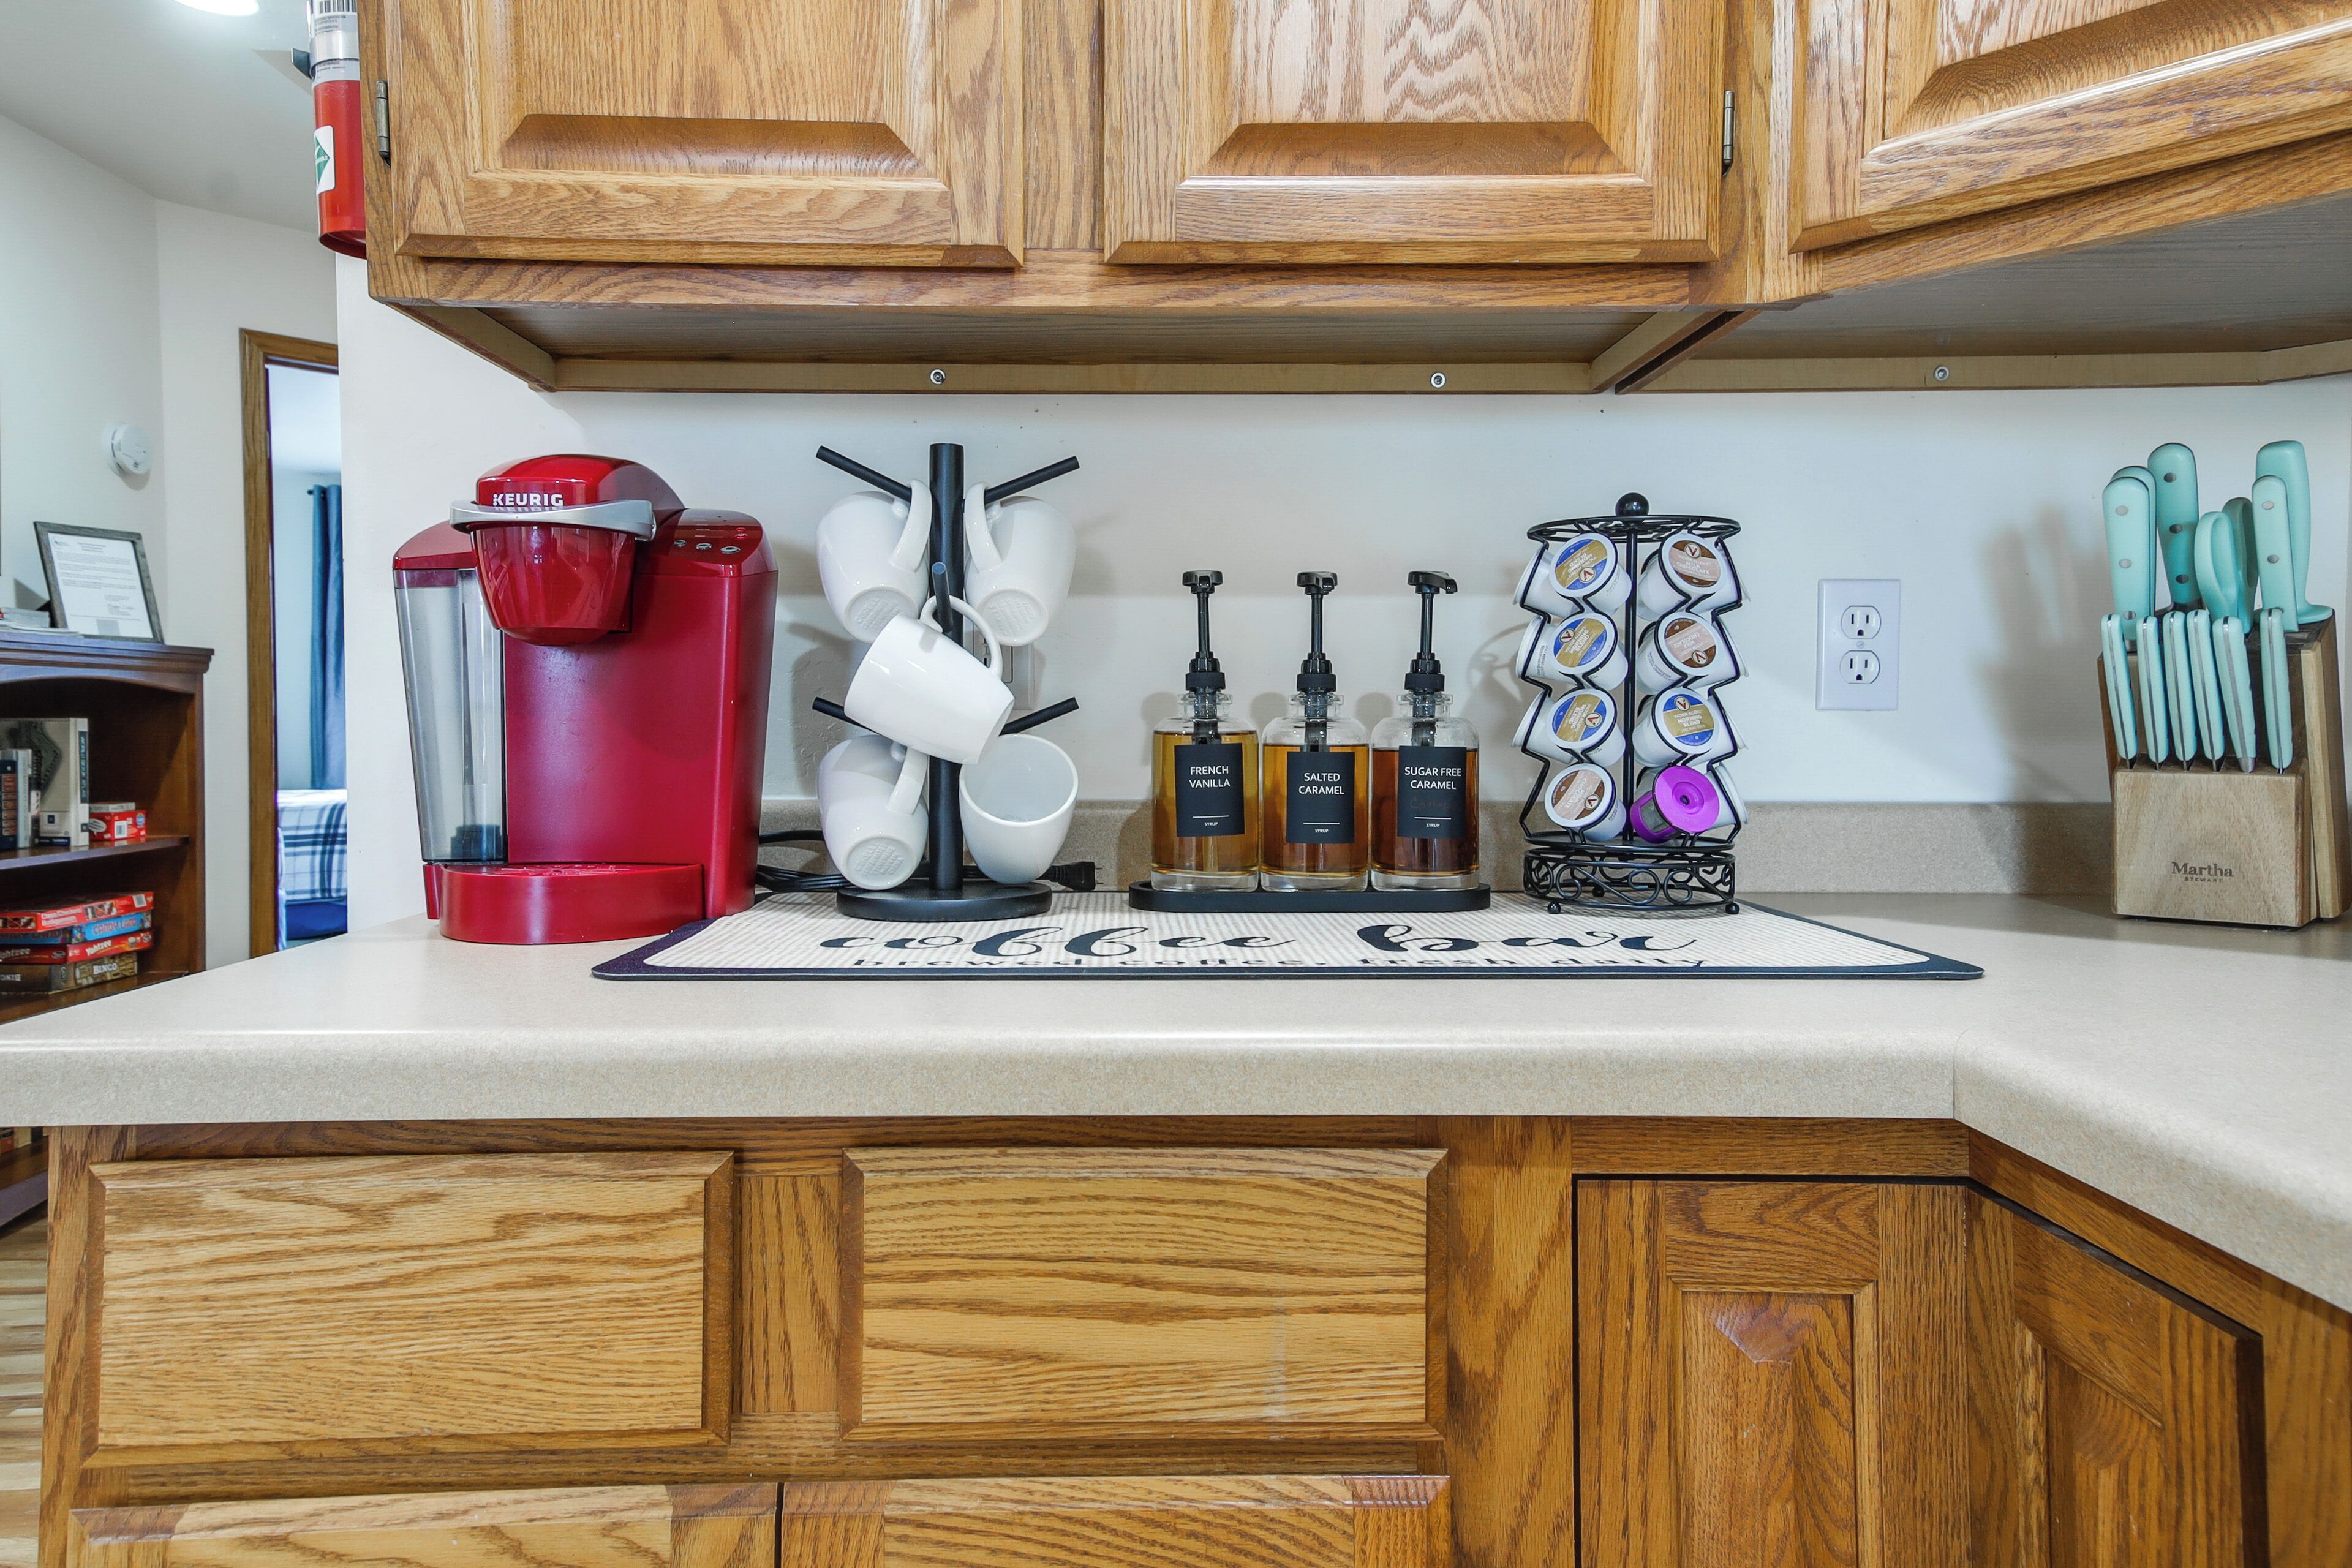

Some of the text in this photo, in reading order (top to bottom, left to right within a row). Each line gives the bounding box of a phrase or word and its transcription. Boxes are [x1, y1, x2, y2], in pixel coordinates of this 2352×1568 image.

[493, 493, 564, 507] KEURIG
[1568, 553, 1593, 573] MORNING
[1676, 561, 1710, 574] CHOCOLATE
[1569, 629, 1589, 654] MORNING
[1575, 635, 1589, 652] BLEND
[1570, 704, 1586, 729] MORNING
[1678, 714, 1702, 724] MORNING
[1190, 766, 1229, 775] FRENCH
[1404, 766, 1461, 777] SUGAR FREE
[1189, 778, 1231, 788] VANILLA
[1304, 772, 1340, 782] SALTED
[1298, 785, 1344, 795] CARAMEL
[1410, 780, 1457, 790] CARAMEL
[2171, 862, 2234, 878] Martha
[93, 918, 137, 935] CANDY LAND
[820, 924, 1697, 957] coffee bar
[0, 948, 31, 959] ahtzee
[85, 940, 111, 956] Yahtzee
[92, 963, 117, 974] BINGO
[1551, 958, 1706, 967] daily
